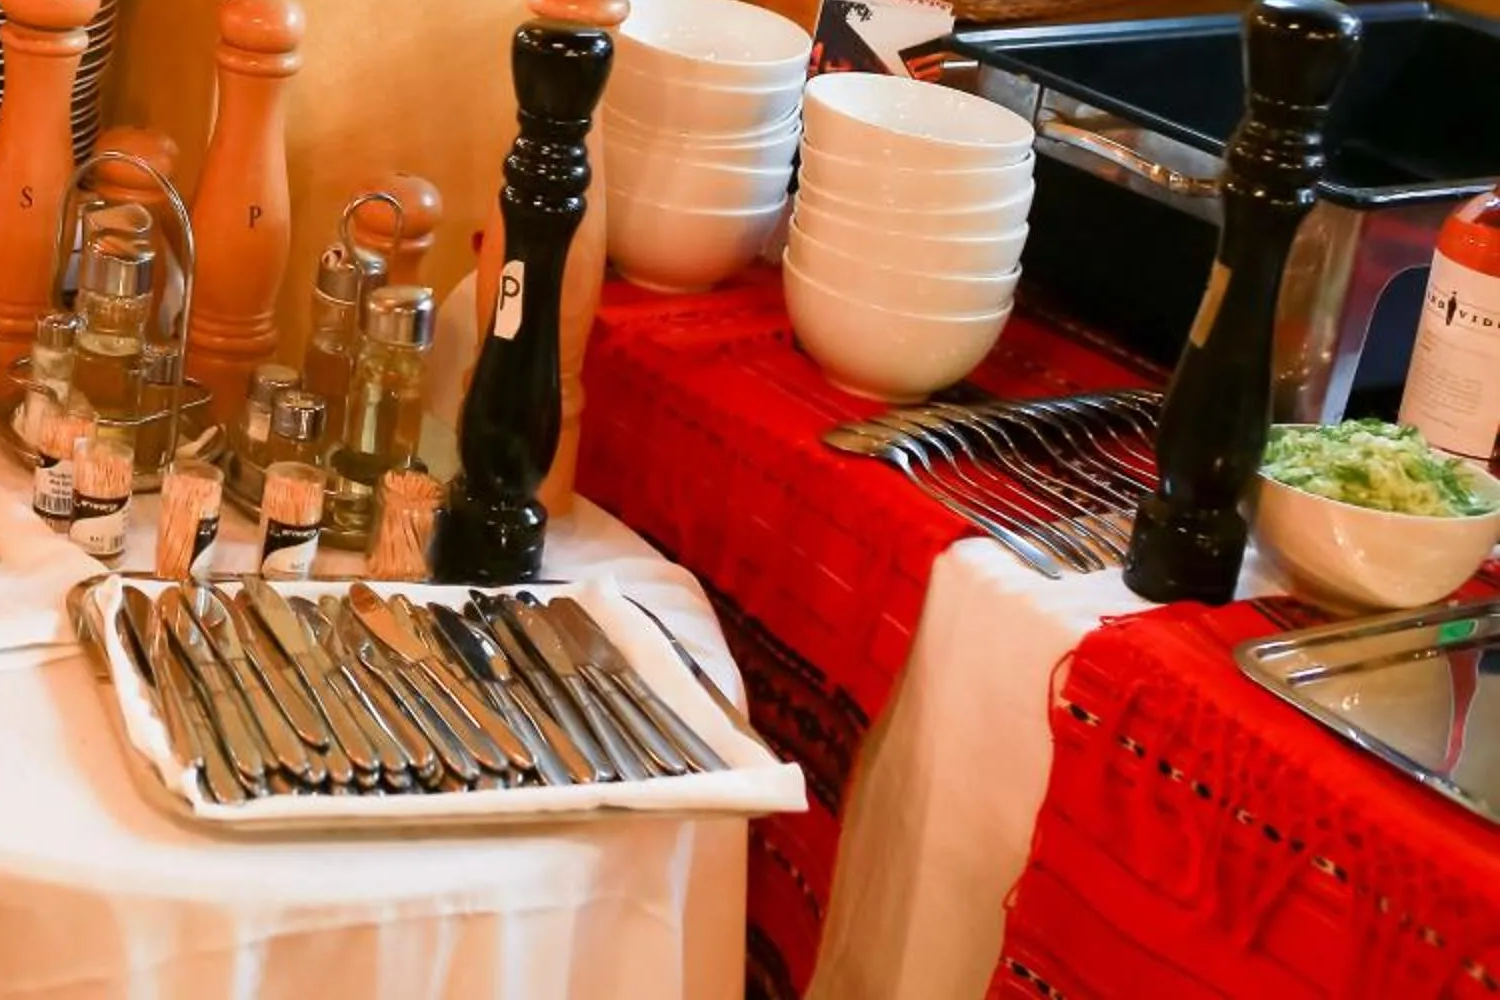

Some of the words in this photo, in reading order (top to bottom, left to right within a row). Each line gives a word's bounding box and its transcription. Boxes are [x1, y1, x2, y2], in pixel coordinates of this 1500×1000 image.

[20, 185, 33, 209] S
[249, 205, 262, 229] P
[499, 275, 520, 311] P
